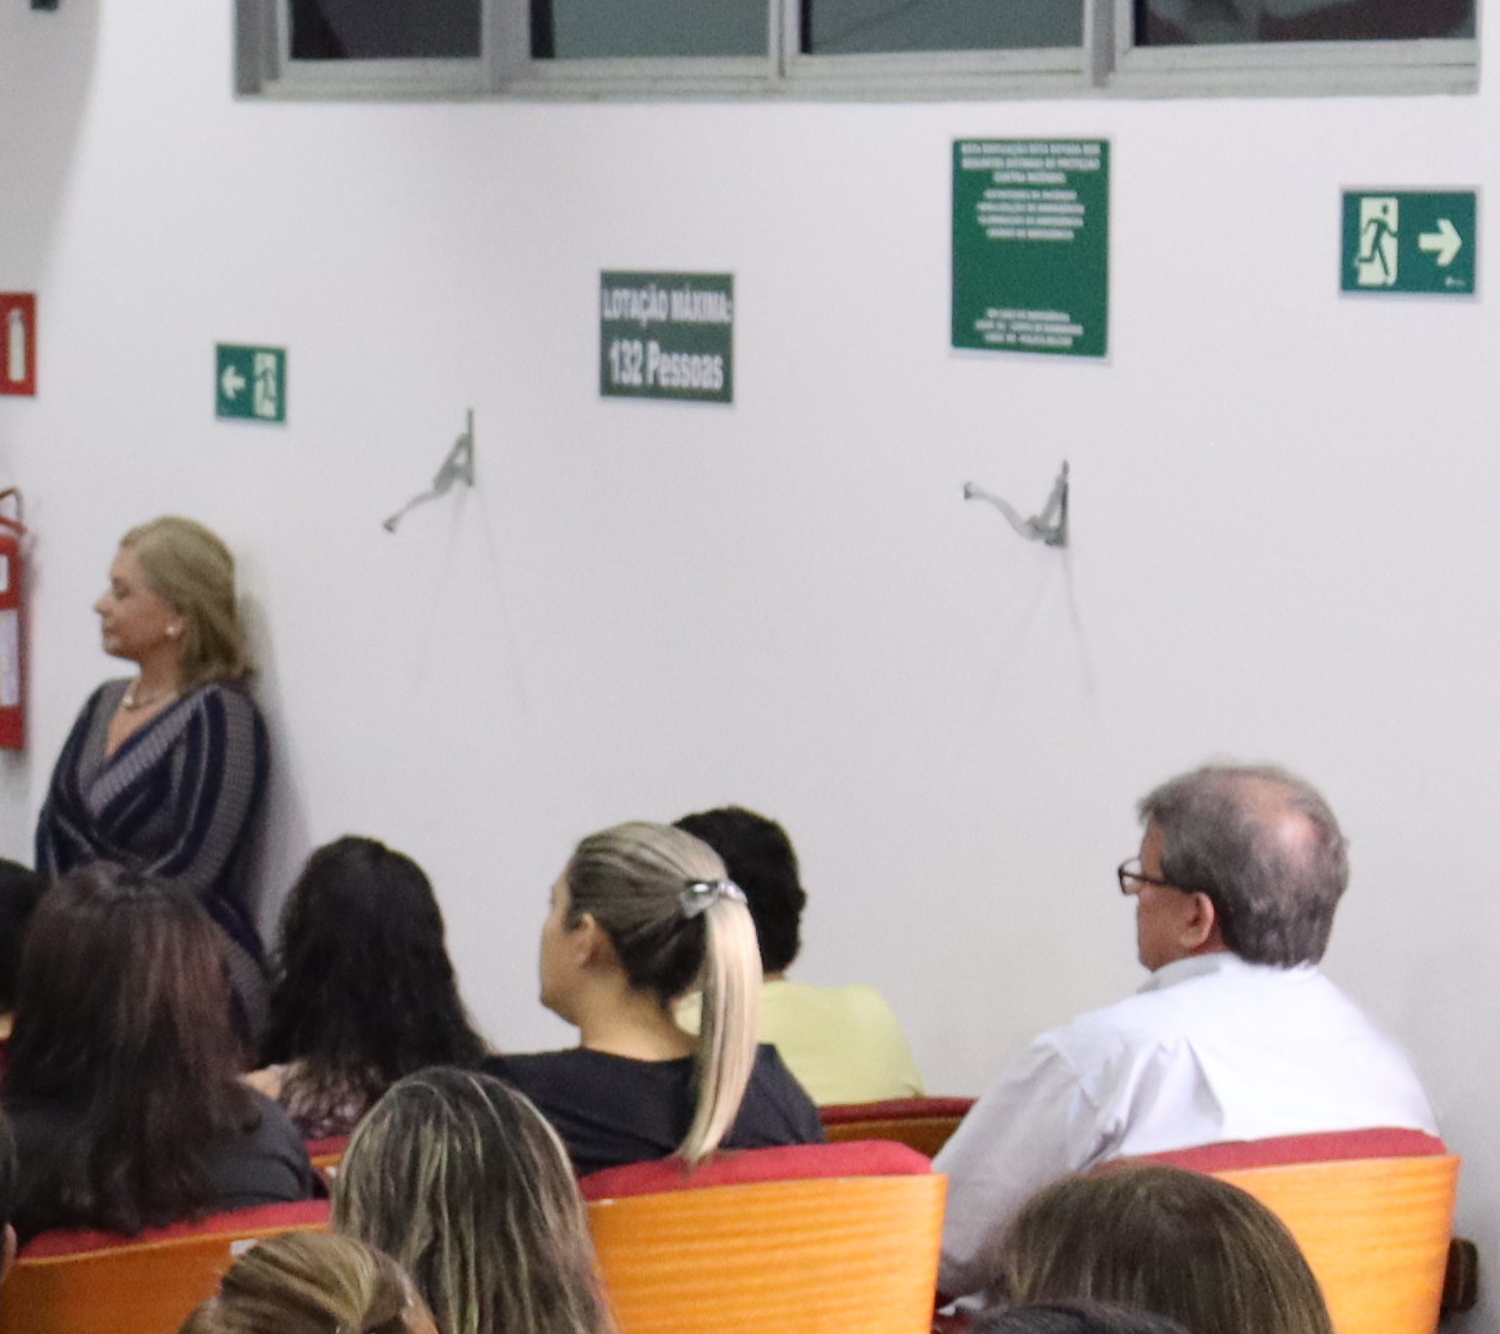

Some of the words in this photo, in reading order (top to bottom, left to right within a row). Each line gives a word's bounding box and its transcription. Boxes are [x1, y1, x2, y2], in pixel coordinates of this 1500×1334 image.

[603, 282, 668, 327] LOTAÇÃO
[609, 339, 642, 385] 132
[646, 340, 723, 391] Pessoas
